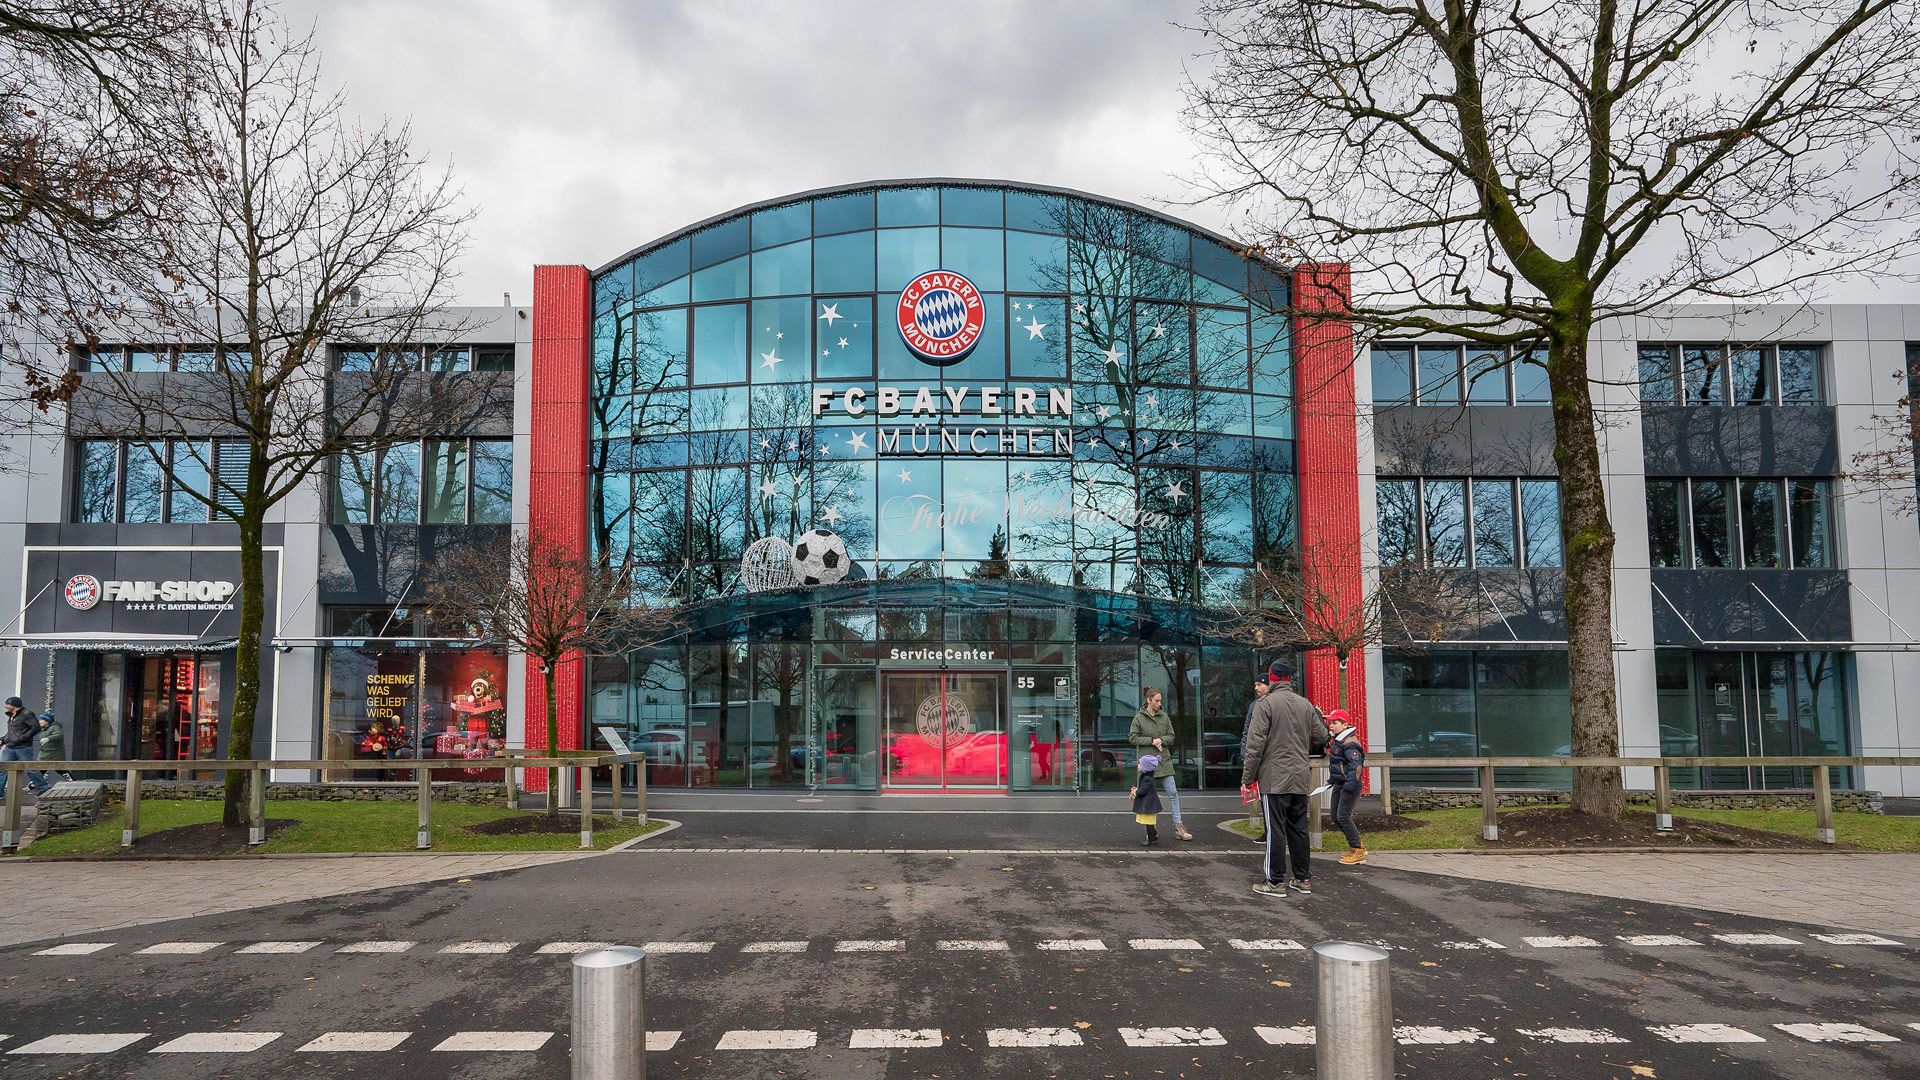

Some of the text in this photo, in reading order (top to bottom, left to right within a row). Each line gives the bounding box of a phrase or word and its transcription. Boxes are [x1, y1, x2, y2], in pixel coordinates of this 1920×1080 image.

[902, 275, 979, 309] FC BAYERN
[878, 422, 1073, 454] MÜNCHEN
[881, 492, 984, 536] Frohe
[103, 580, 234, 602] FAN-SHOP
[197, 602, 234, 611] MÜNCHEN
[367, 674, 415, 684] SCHENKE
[1017, 676, 1035, 689] 55
[367, 685, 390, 696] WAS
[366, 696, 408, 707] GELIEBT
[920, 704, 930, 717] FC
